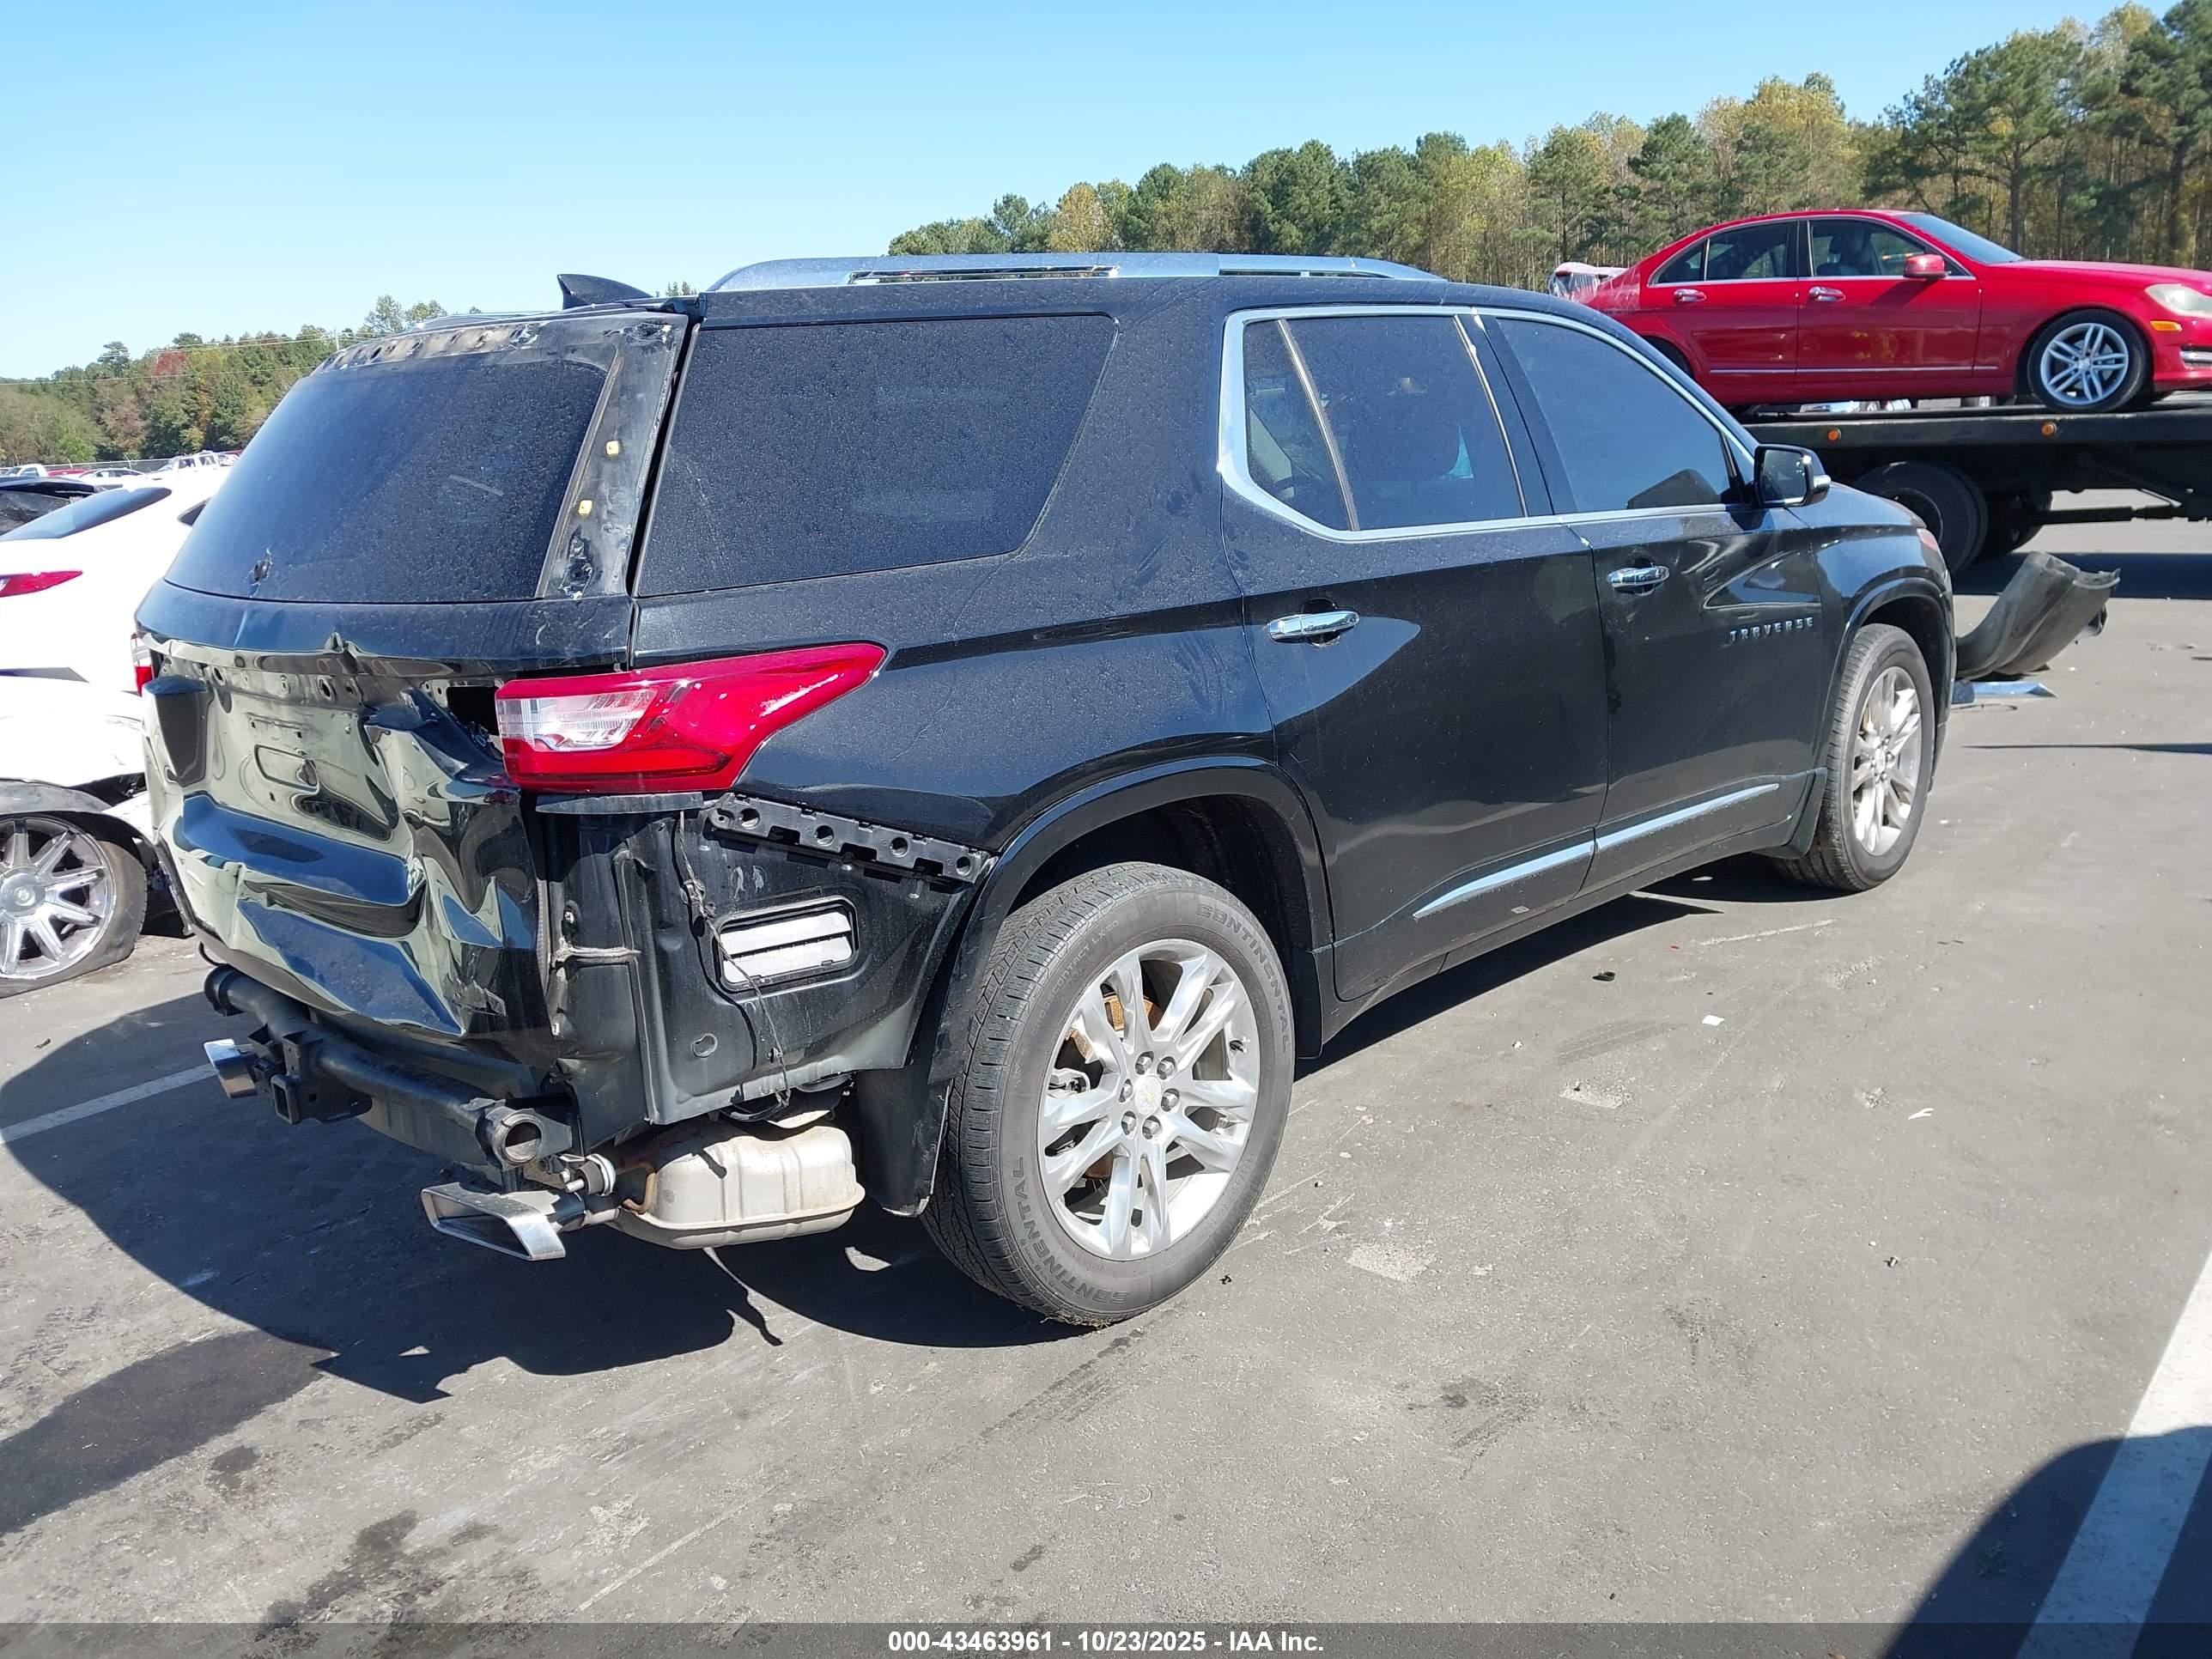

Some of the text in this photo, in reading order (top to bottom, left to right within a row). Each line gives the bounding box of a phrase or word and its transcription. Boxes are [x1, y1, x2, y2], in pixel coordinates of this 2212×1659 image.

[1729, 617, 1814, 641] TRAVERSE
[1195, 903, 1290, 1054] CONTINENTAL
[1012, 1155, 1131, 1304] CONTINENTAL
